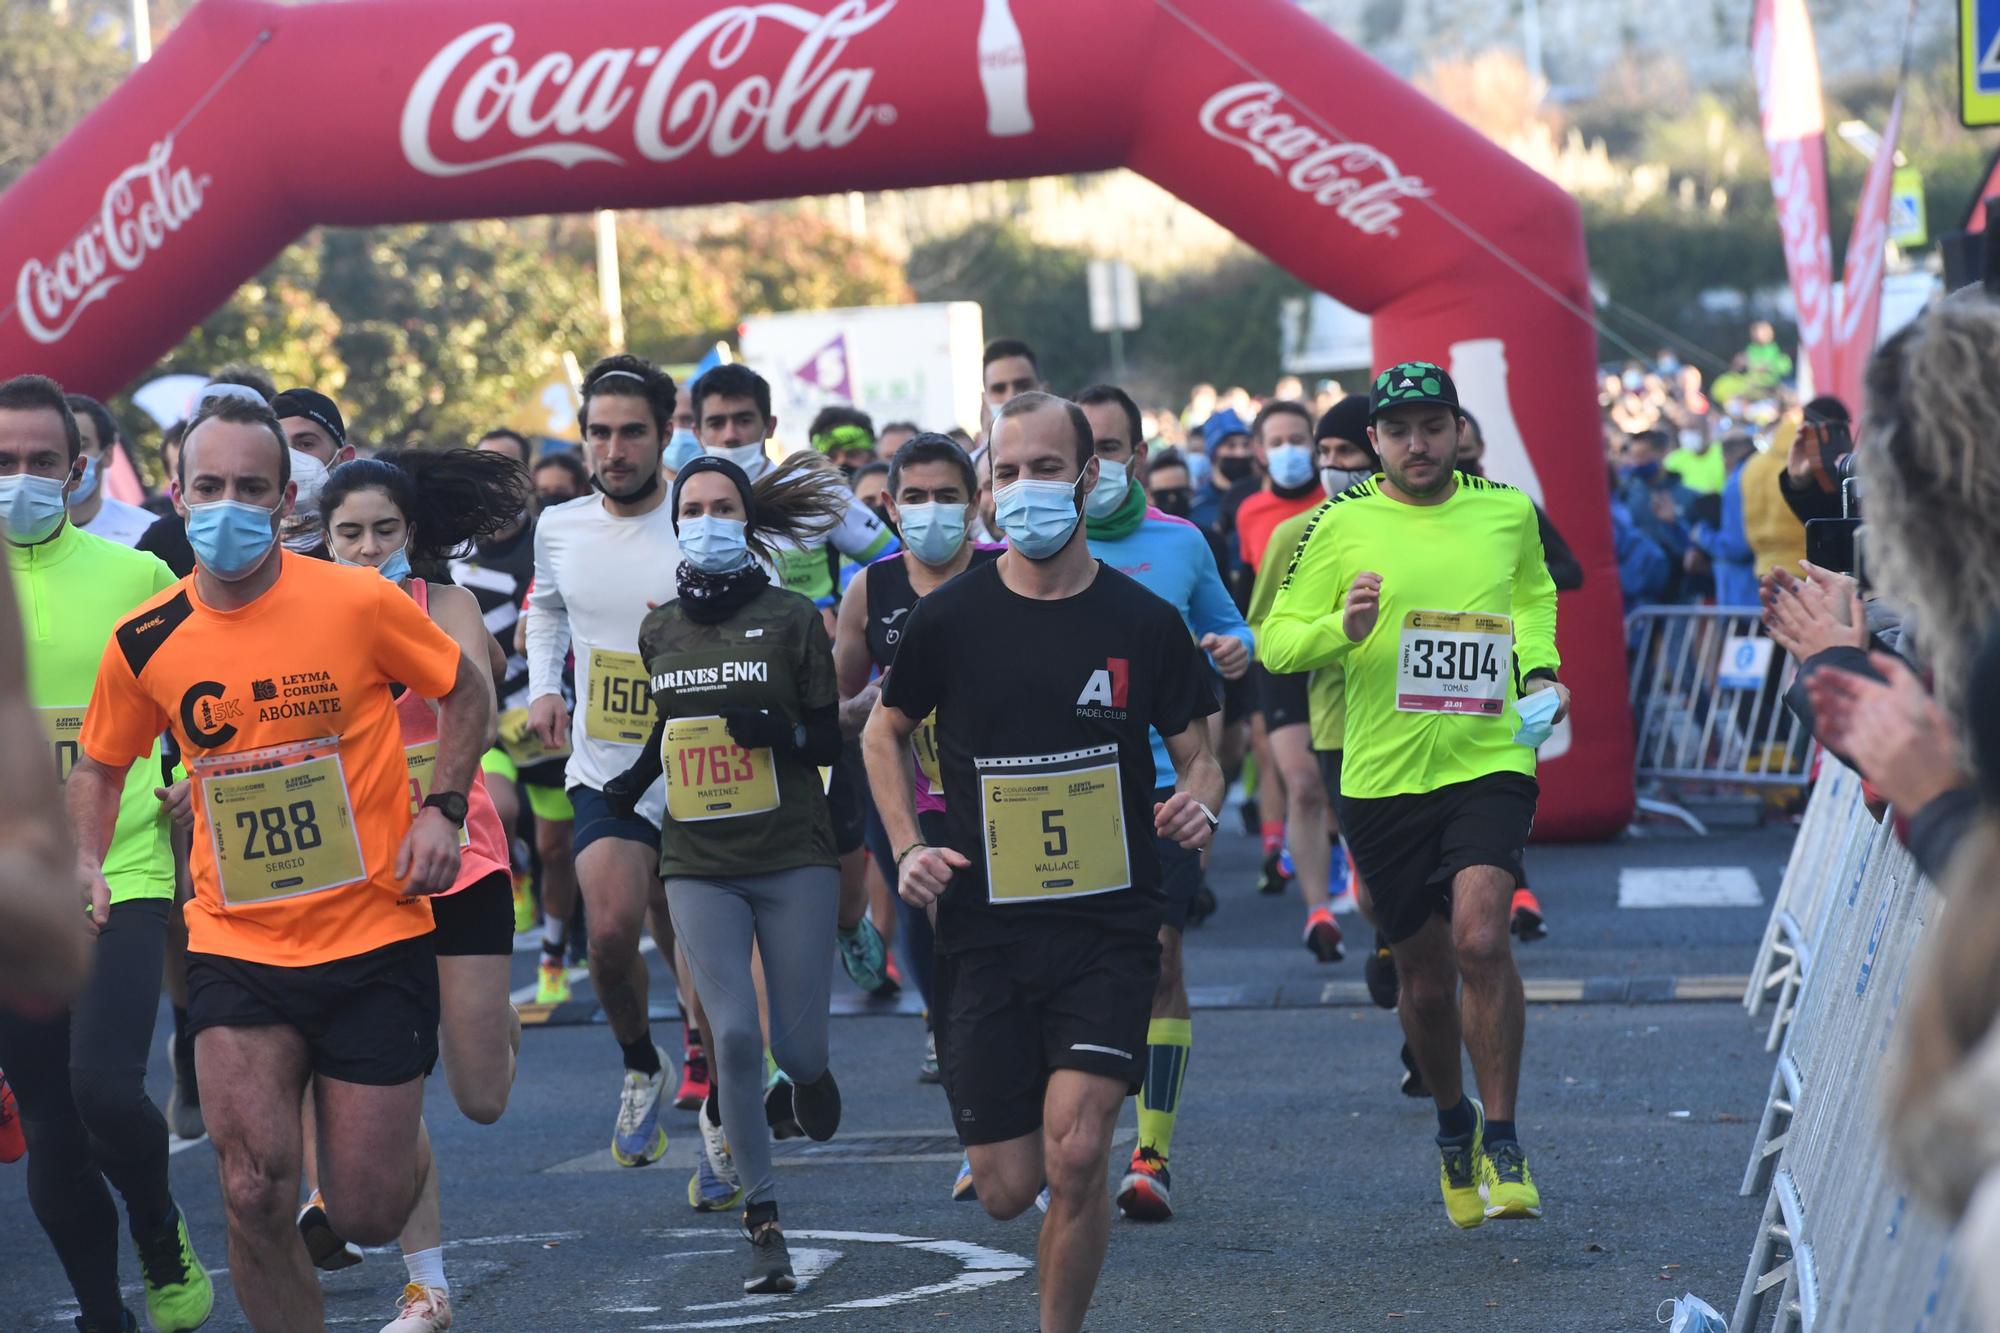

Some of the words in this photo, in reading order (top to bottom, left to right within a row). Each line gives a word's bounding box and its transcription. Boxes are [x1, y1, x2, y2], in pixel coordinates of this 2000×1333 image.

[400, 0, 898, 177] Coca-Cola
[1199, 82, 1434, 235] Coca-Cola
[17, 136, 205, 343] Coca-Cola
[722, 662, 768, 682] ENKI
[1413, 639, 1498, 682] 3304
[282, 671, 331, 686] LEYMA
[283, 682, 338, 698] CORUÑA
[1442, 683, 1469, 693] TOMÁS
[211, 698, 244, 723] 5K
[259, 697, 342, 723] ABÓNATE
[1076, 708, 1103, 718] PADEL
[1103, 710, 1127, 720] CLUB
[678, 744, 754, 787] 1763
[697, 787, 740, 798] MARTINEZ
[215, 821, 225, 854] TANDA
[236, 799, 322, 861] 288
[989, 819, 997, 849] TANDA
[1041, 809, 1068, 857] 5
[265, 857, 305, 873] SERGIO
[1034, 860, 1080, 873] WALLACE
